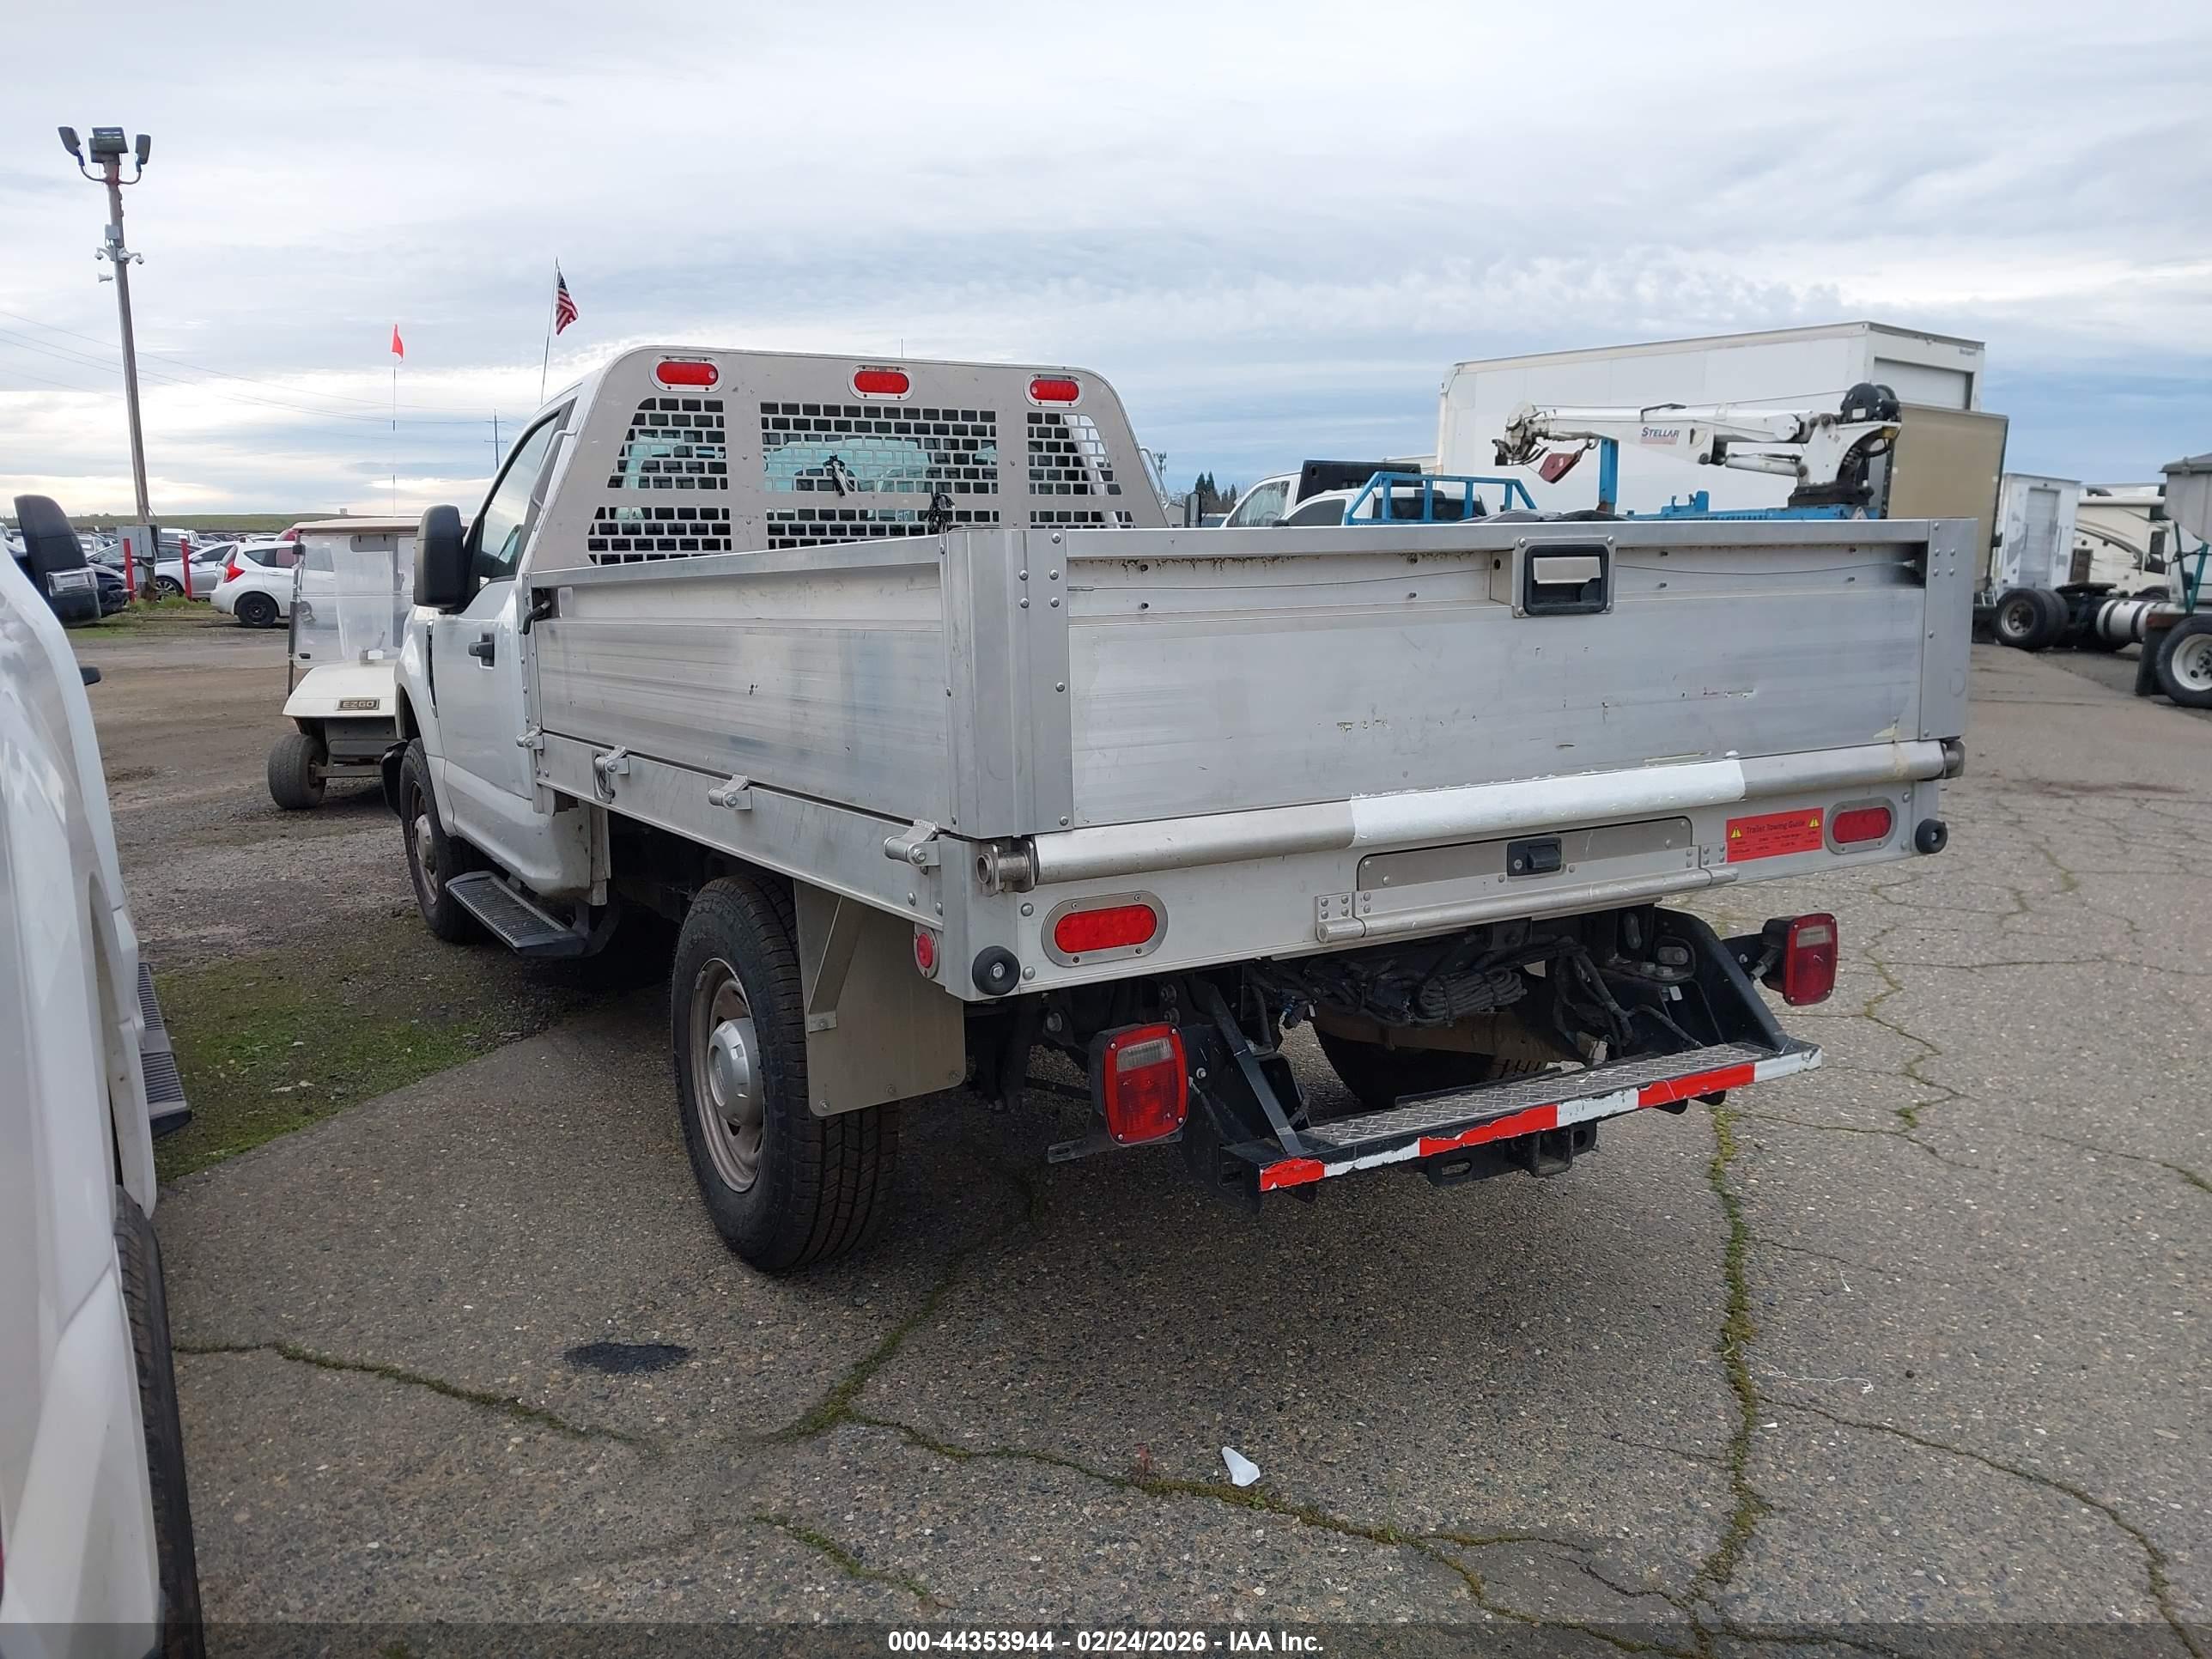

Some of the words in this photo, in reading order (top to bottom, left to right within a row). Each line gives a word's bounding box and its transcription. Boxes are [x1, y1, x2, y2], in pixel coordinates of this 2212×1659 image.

[1641, 427, 1680, 438] STELLAR
[1747, 824, 1765, 835] Trailer
[1767, 823, 1788, 831] Towing
[1789, 820, 1806, 829] Guide
